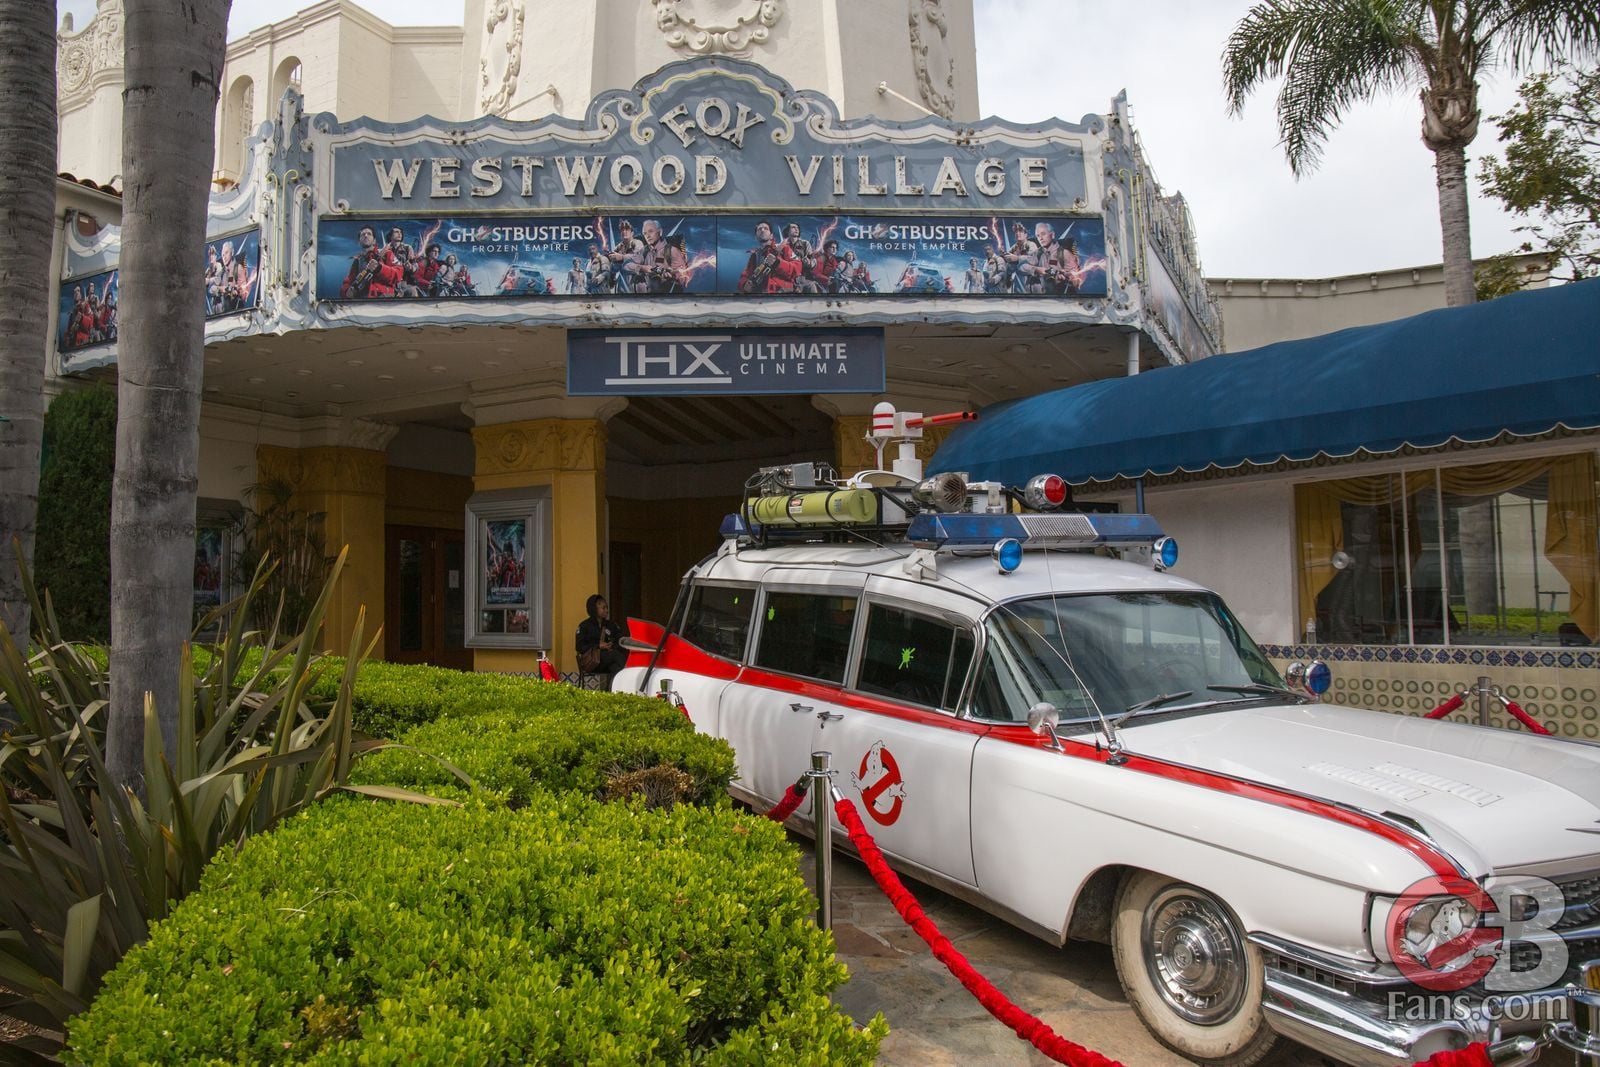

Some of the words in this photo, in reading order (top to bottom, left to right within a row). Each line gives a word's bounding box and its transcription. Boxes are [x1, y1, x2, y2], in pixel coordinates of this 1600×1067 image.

[659, 97, 765, 149] FOX
[371, 154, 727, 199] WESTWOOD
[785, 155, 1049, 197] VILLAGE
[447, 225, 594, 243] GHOSTBUSTERS
[845, 224, 989, 241] GHOSTBUSTERS
[472, 245, 519, 253] FROZEN
[525, 243, 569, 252] EMPIRE
[870, 242, 915, 251] FROZEN
[922, 242, 966, 251] EMPIRE
[605, 336, 732, 377] THX
[740, 343, 847, 360] ULTIMATE
[740, 362, 847, 374] CINEMA
